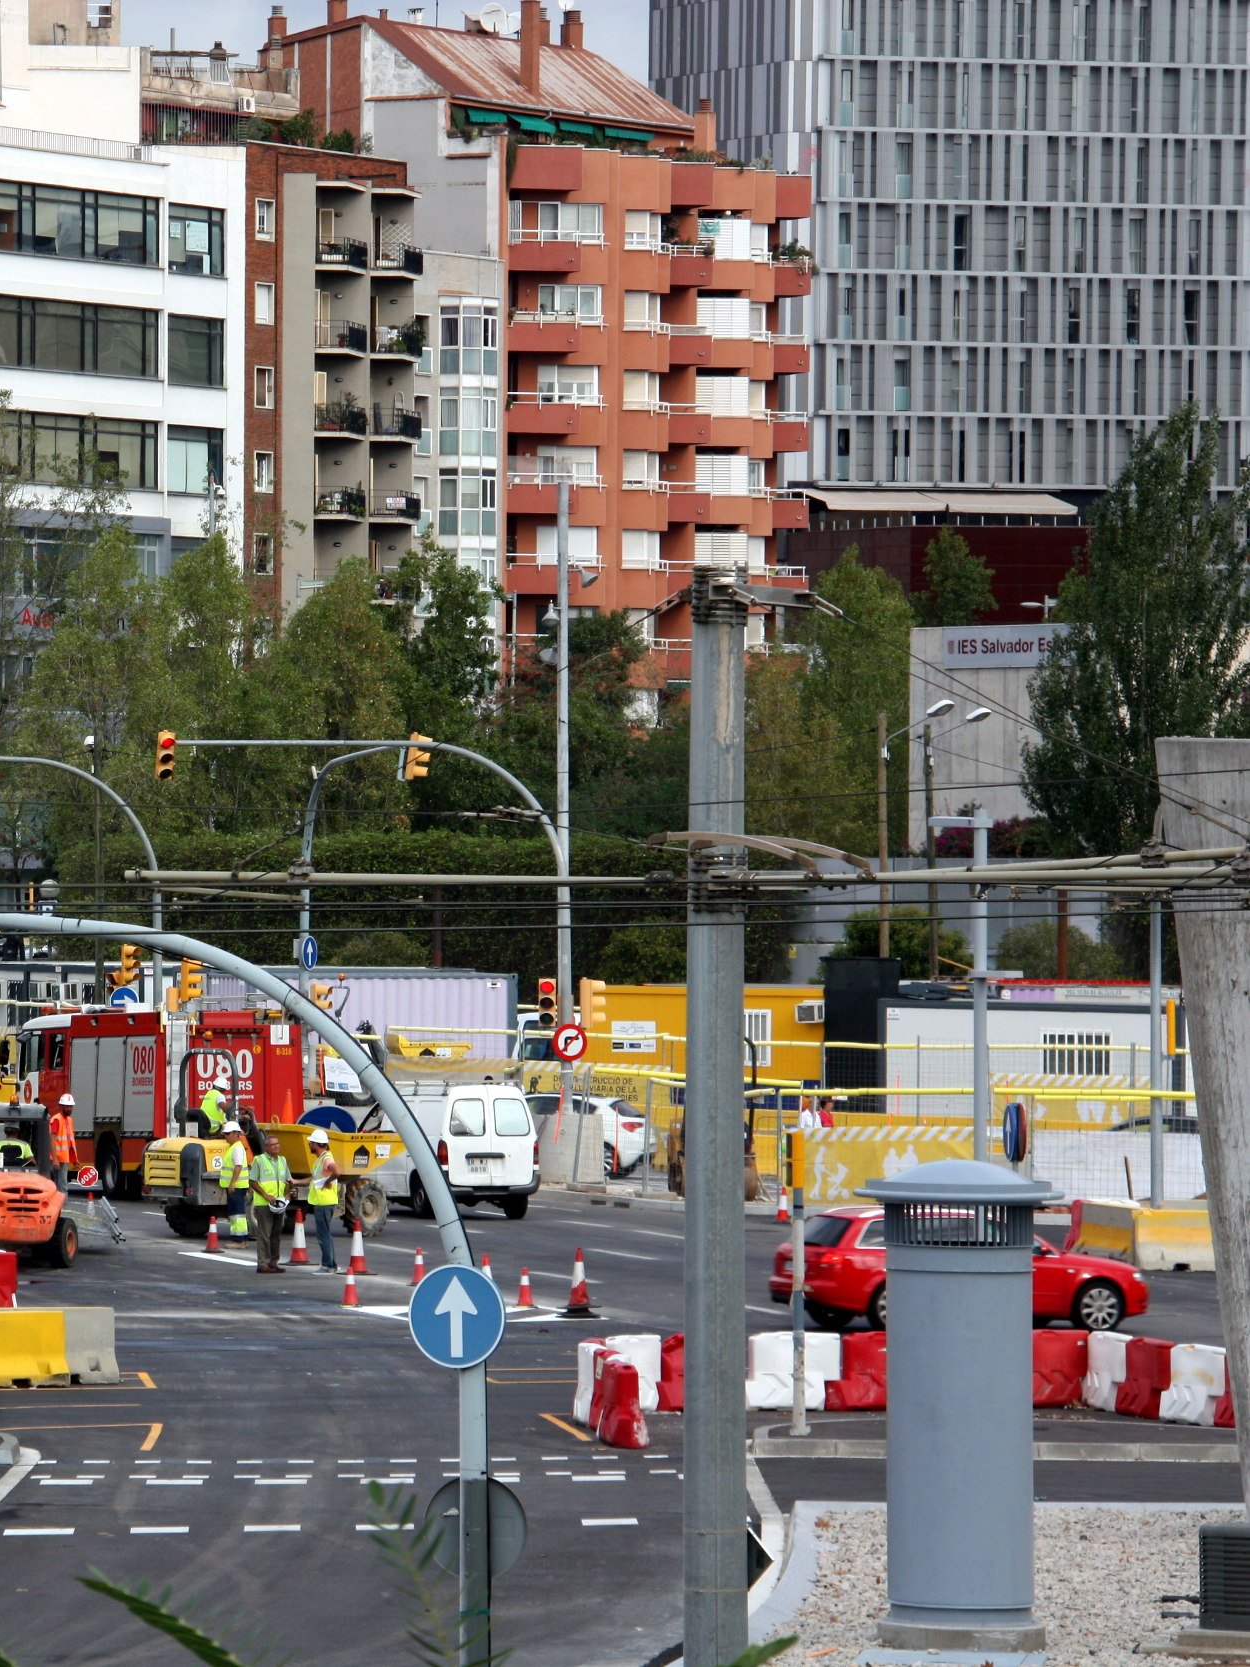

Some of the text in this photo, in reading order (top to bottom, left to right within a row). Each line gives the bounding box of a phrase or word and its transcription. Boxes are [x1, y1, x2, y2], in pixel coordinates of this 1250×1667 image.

[957, 639, 978, 655] IES
[981, 638, 1034, 654] Salvador
[133, 1046, 154, 1075] 080
[196, 1049, 254, 1078] 080
[214, 1158, 223, 1168] 25
[80, 1168, 96, 1185] STOP
